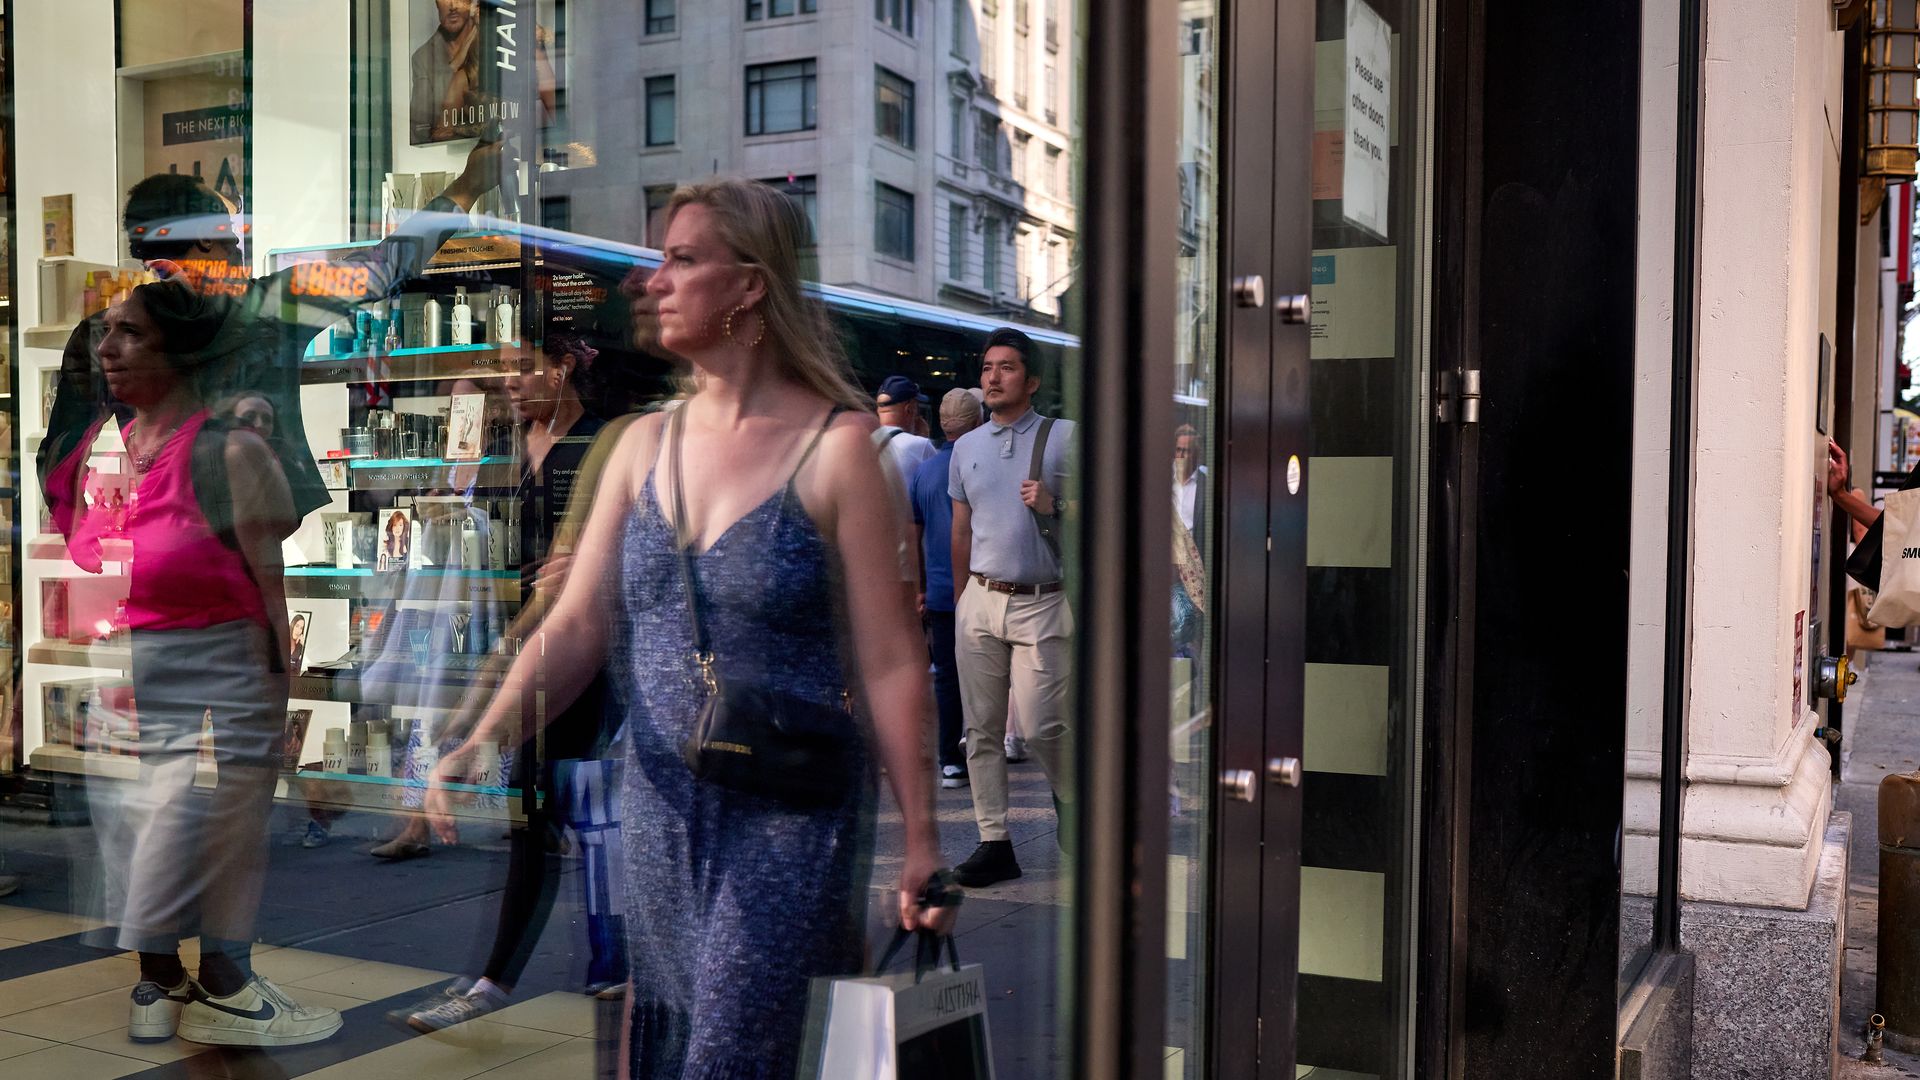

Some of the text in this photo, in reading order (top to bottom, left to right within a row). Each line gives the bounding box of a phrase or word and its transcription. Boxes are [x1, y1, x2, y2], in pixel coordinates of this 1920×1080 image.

[496, 0, 517, 72] HAI
[1355, 56, 1384, 94] Please use
[175, 120, 195, 135] THE
[199, 116, 226, 131] NEXT
[1352, 93, 1386, 132] other doors,
[1354, 128, 1370, 153] thank
[1371, 142, 1383, 161] you.
[440, 245, 494, 255] FINISHING TOUCHES
